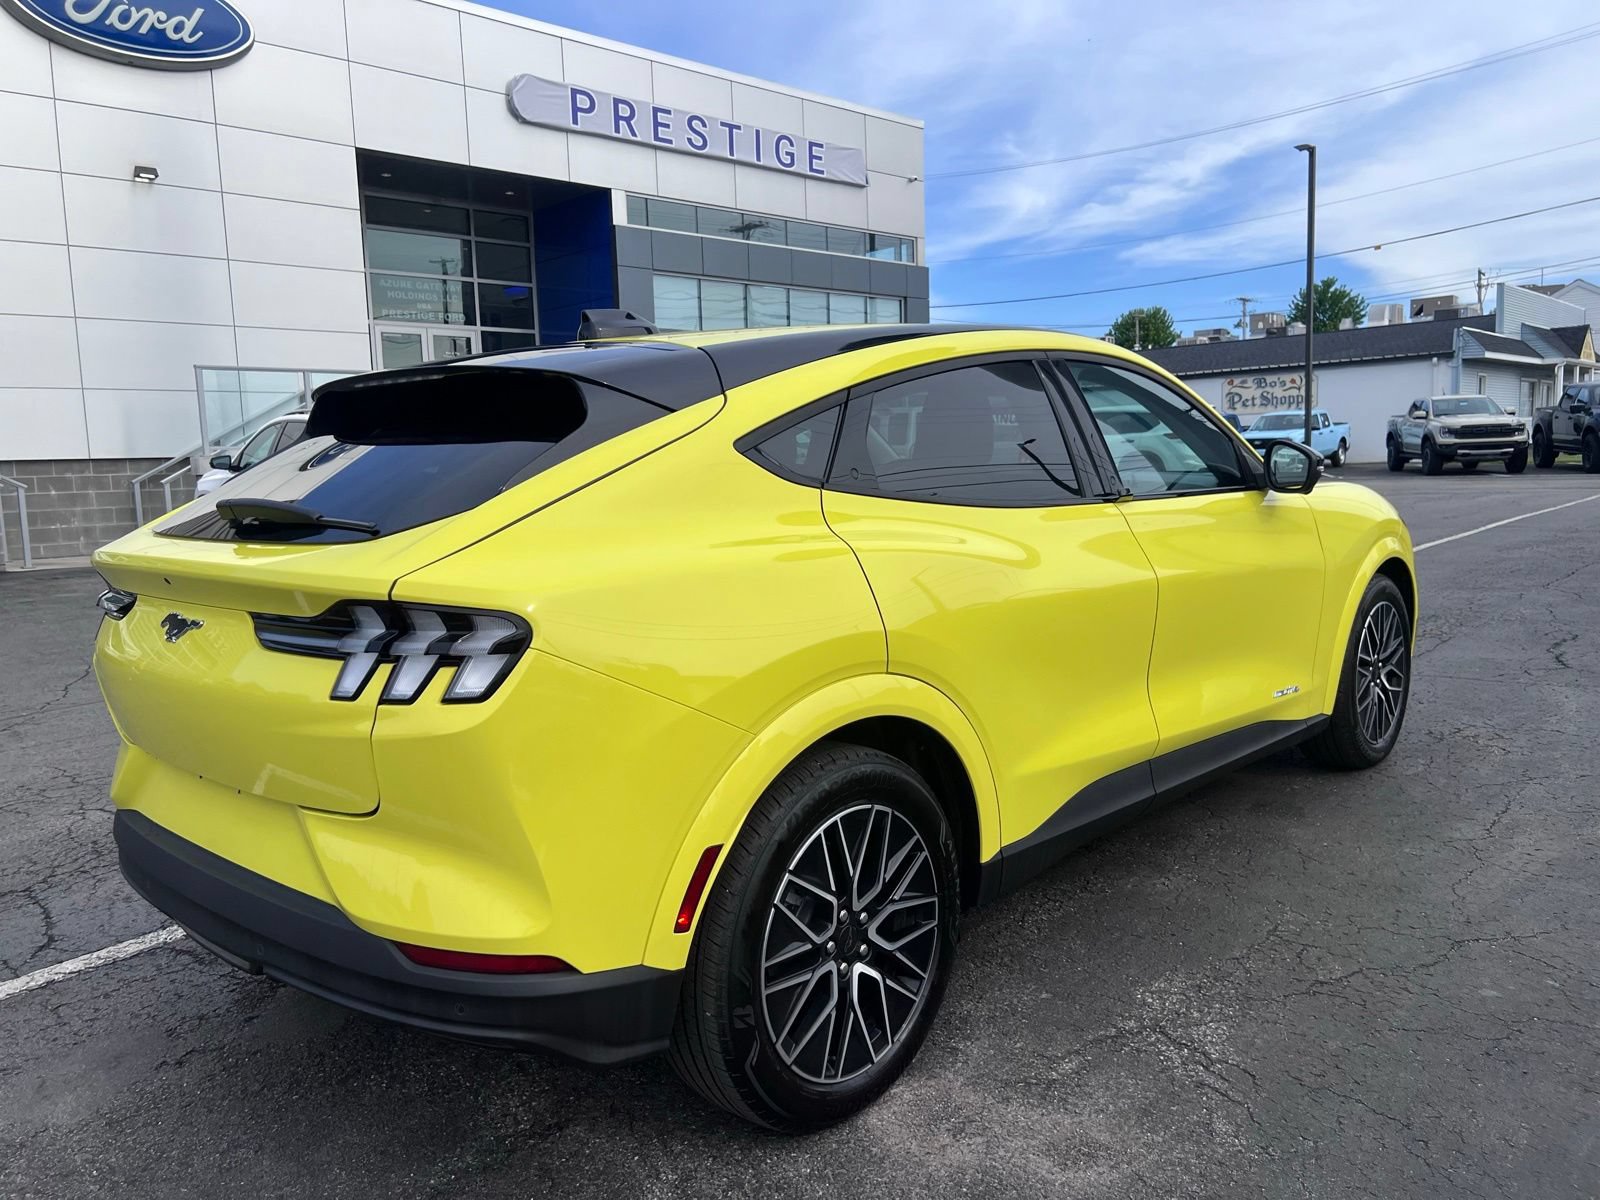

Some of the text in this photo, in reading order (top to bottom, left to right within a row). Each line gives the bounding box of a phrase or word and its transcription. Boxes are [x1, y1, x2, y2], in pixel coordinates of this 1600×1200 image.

[568, 86, 827, 176] PRESTIGE
[388, 290, 438, 301] HOLDINGS
[382, 309, 466, 322] PRESTIGE FORD
[1252, 377, 1287, 389] Bo's
[1225, 390, 1309, 410] Pet Shopp
